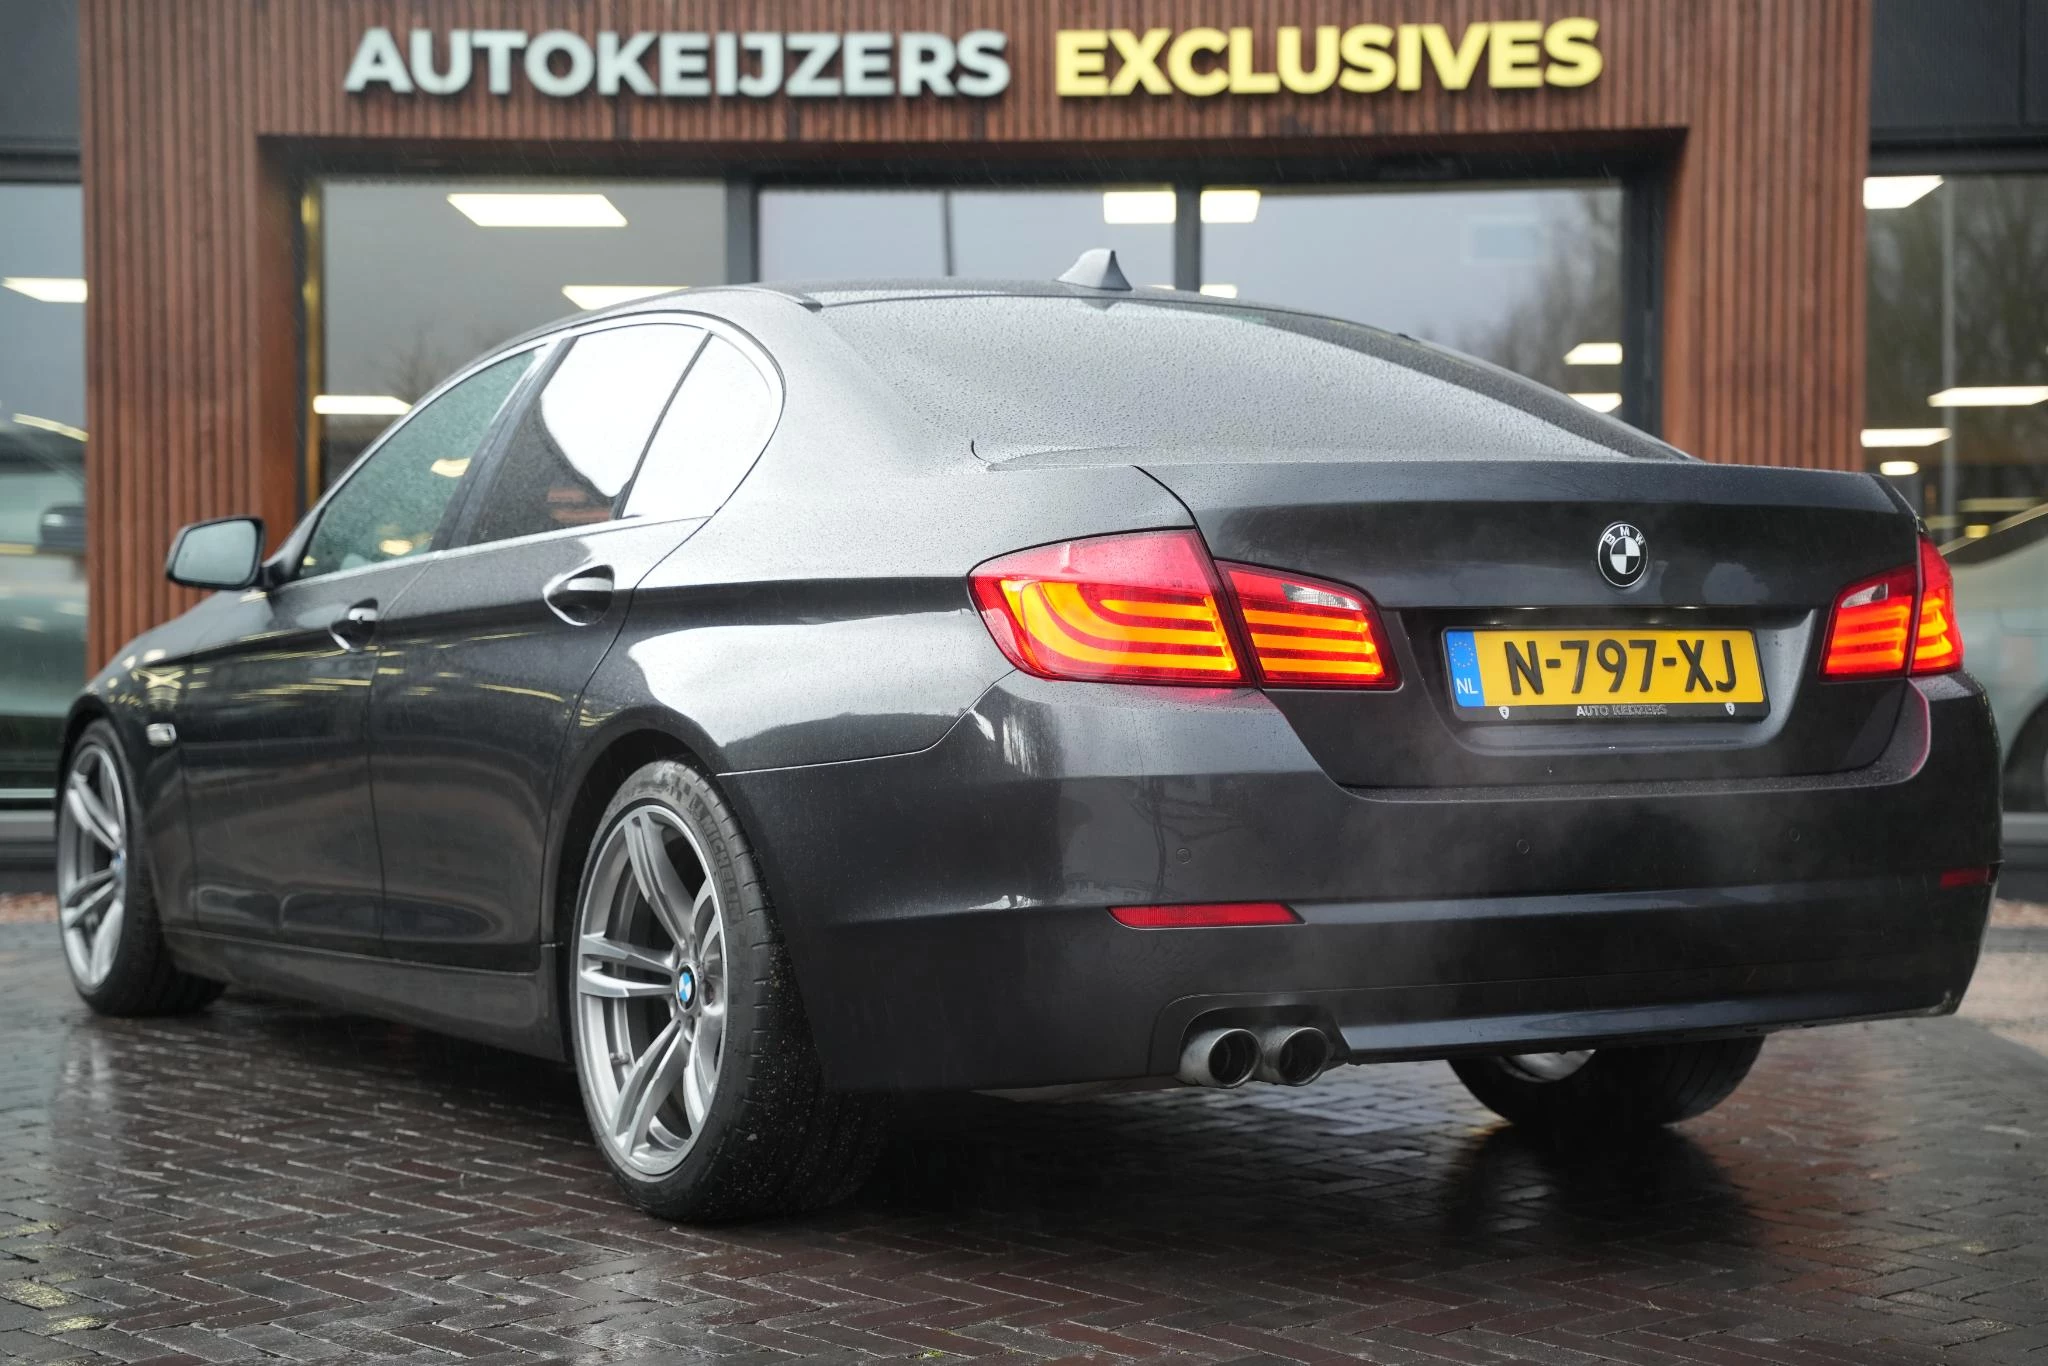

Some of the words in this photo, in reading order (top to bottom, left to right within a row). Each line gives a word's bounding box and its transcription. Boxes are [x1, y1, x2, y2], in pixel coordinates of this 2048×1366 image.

[344, 28, 1011, 98] AUTOKEIJZERS
[1055, 17, 1603, 97] EXCLUSIVES
[1604, 526, 1646, 546] BMW
[1456, 677, 1479, 694] NL
[1504, 638, 1738, 696] N-797-XJ
[1576, 705, 1609, 717] AUTO
[702, 815, 743, 924] MICHELIN
